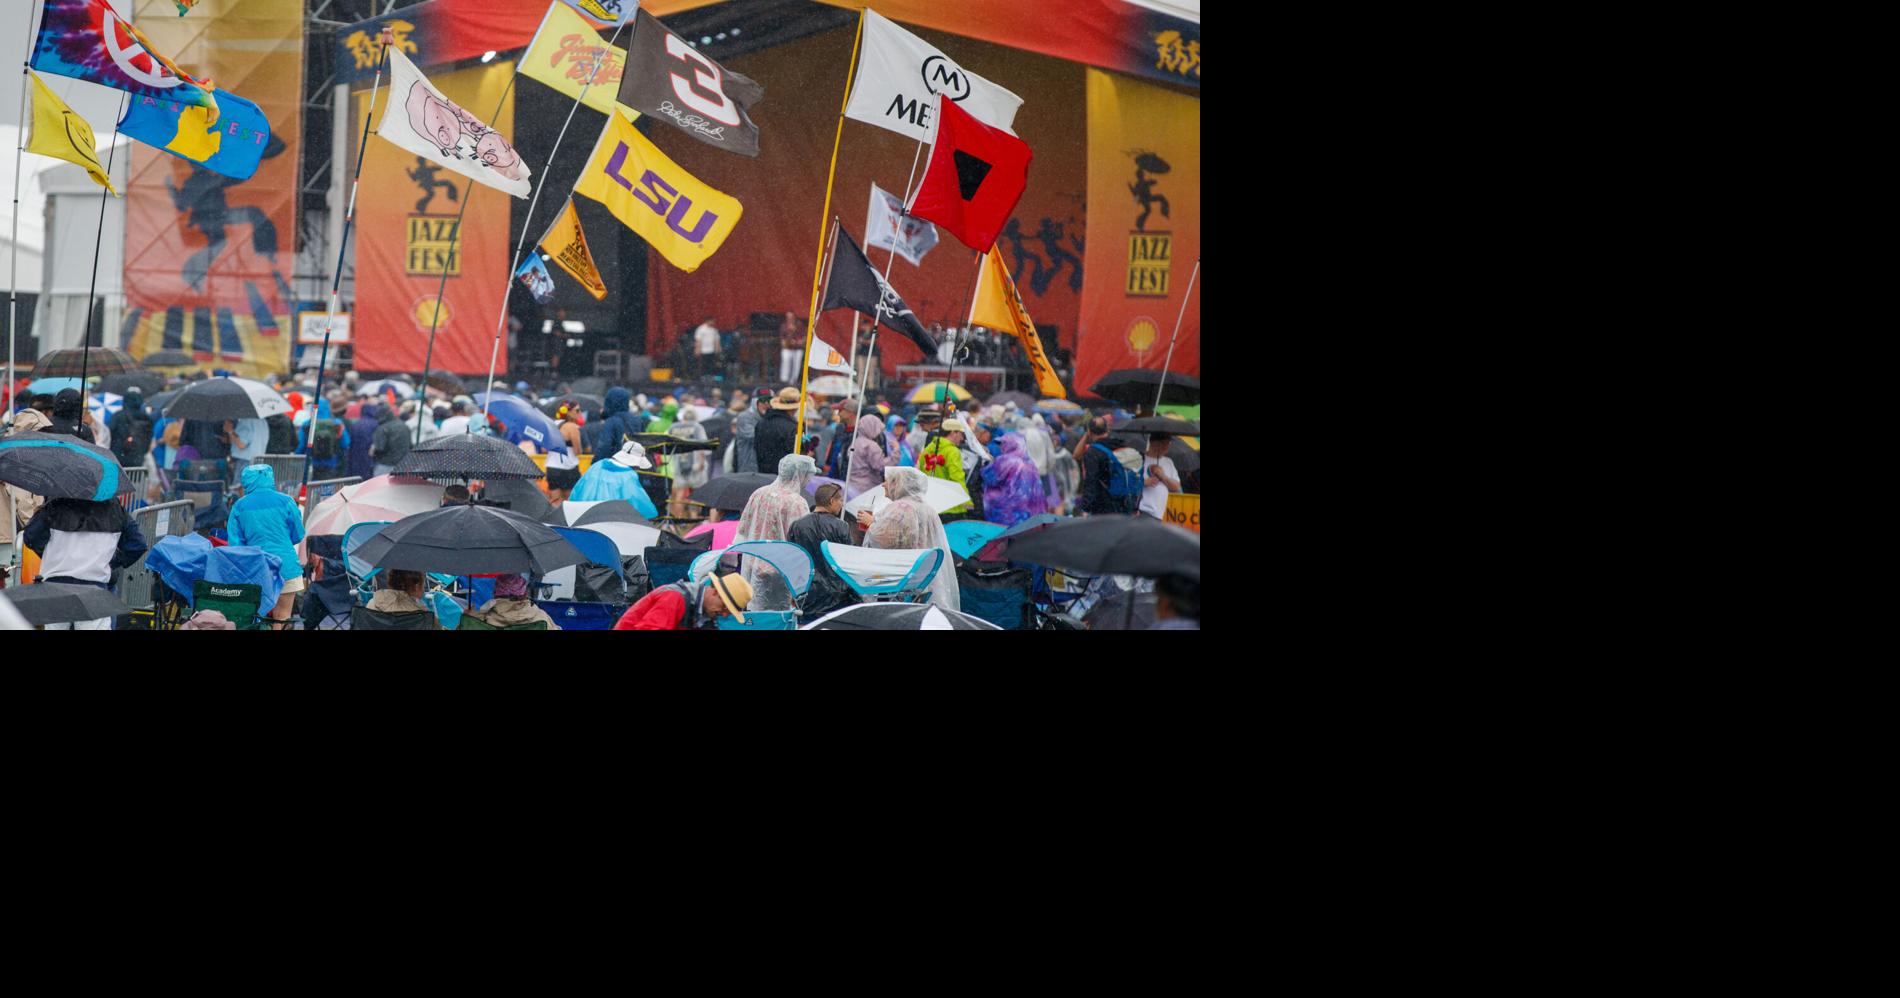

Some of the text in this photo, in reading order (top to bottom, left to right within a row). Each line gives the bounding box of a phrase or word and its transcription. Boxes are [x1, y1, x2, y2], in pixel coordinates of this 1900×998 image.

[664, 32, 741, 127] 3
[932, 63, 960, 92] M
[885, 93, 930, 129] ME
[219, 117, 267, 145] FEST
[604, 139, 719, 243] LSU
[408, 219, 459, 244] JAZZ
[408, 247, 460, 271] FEST
[1130, 236, 1169, 262] JAZZ
[1128, 267, 1168, 291] FEST
[1166, 508, 1187, 524] No
[211, 586, 242, 596] Academy
